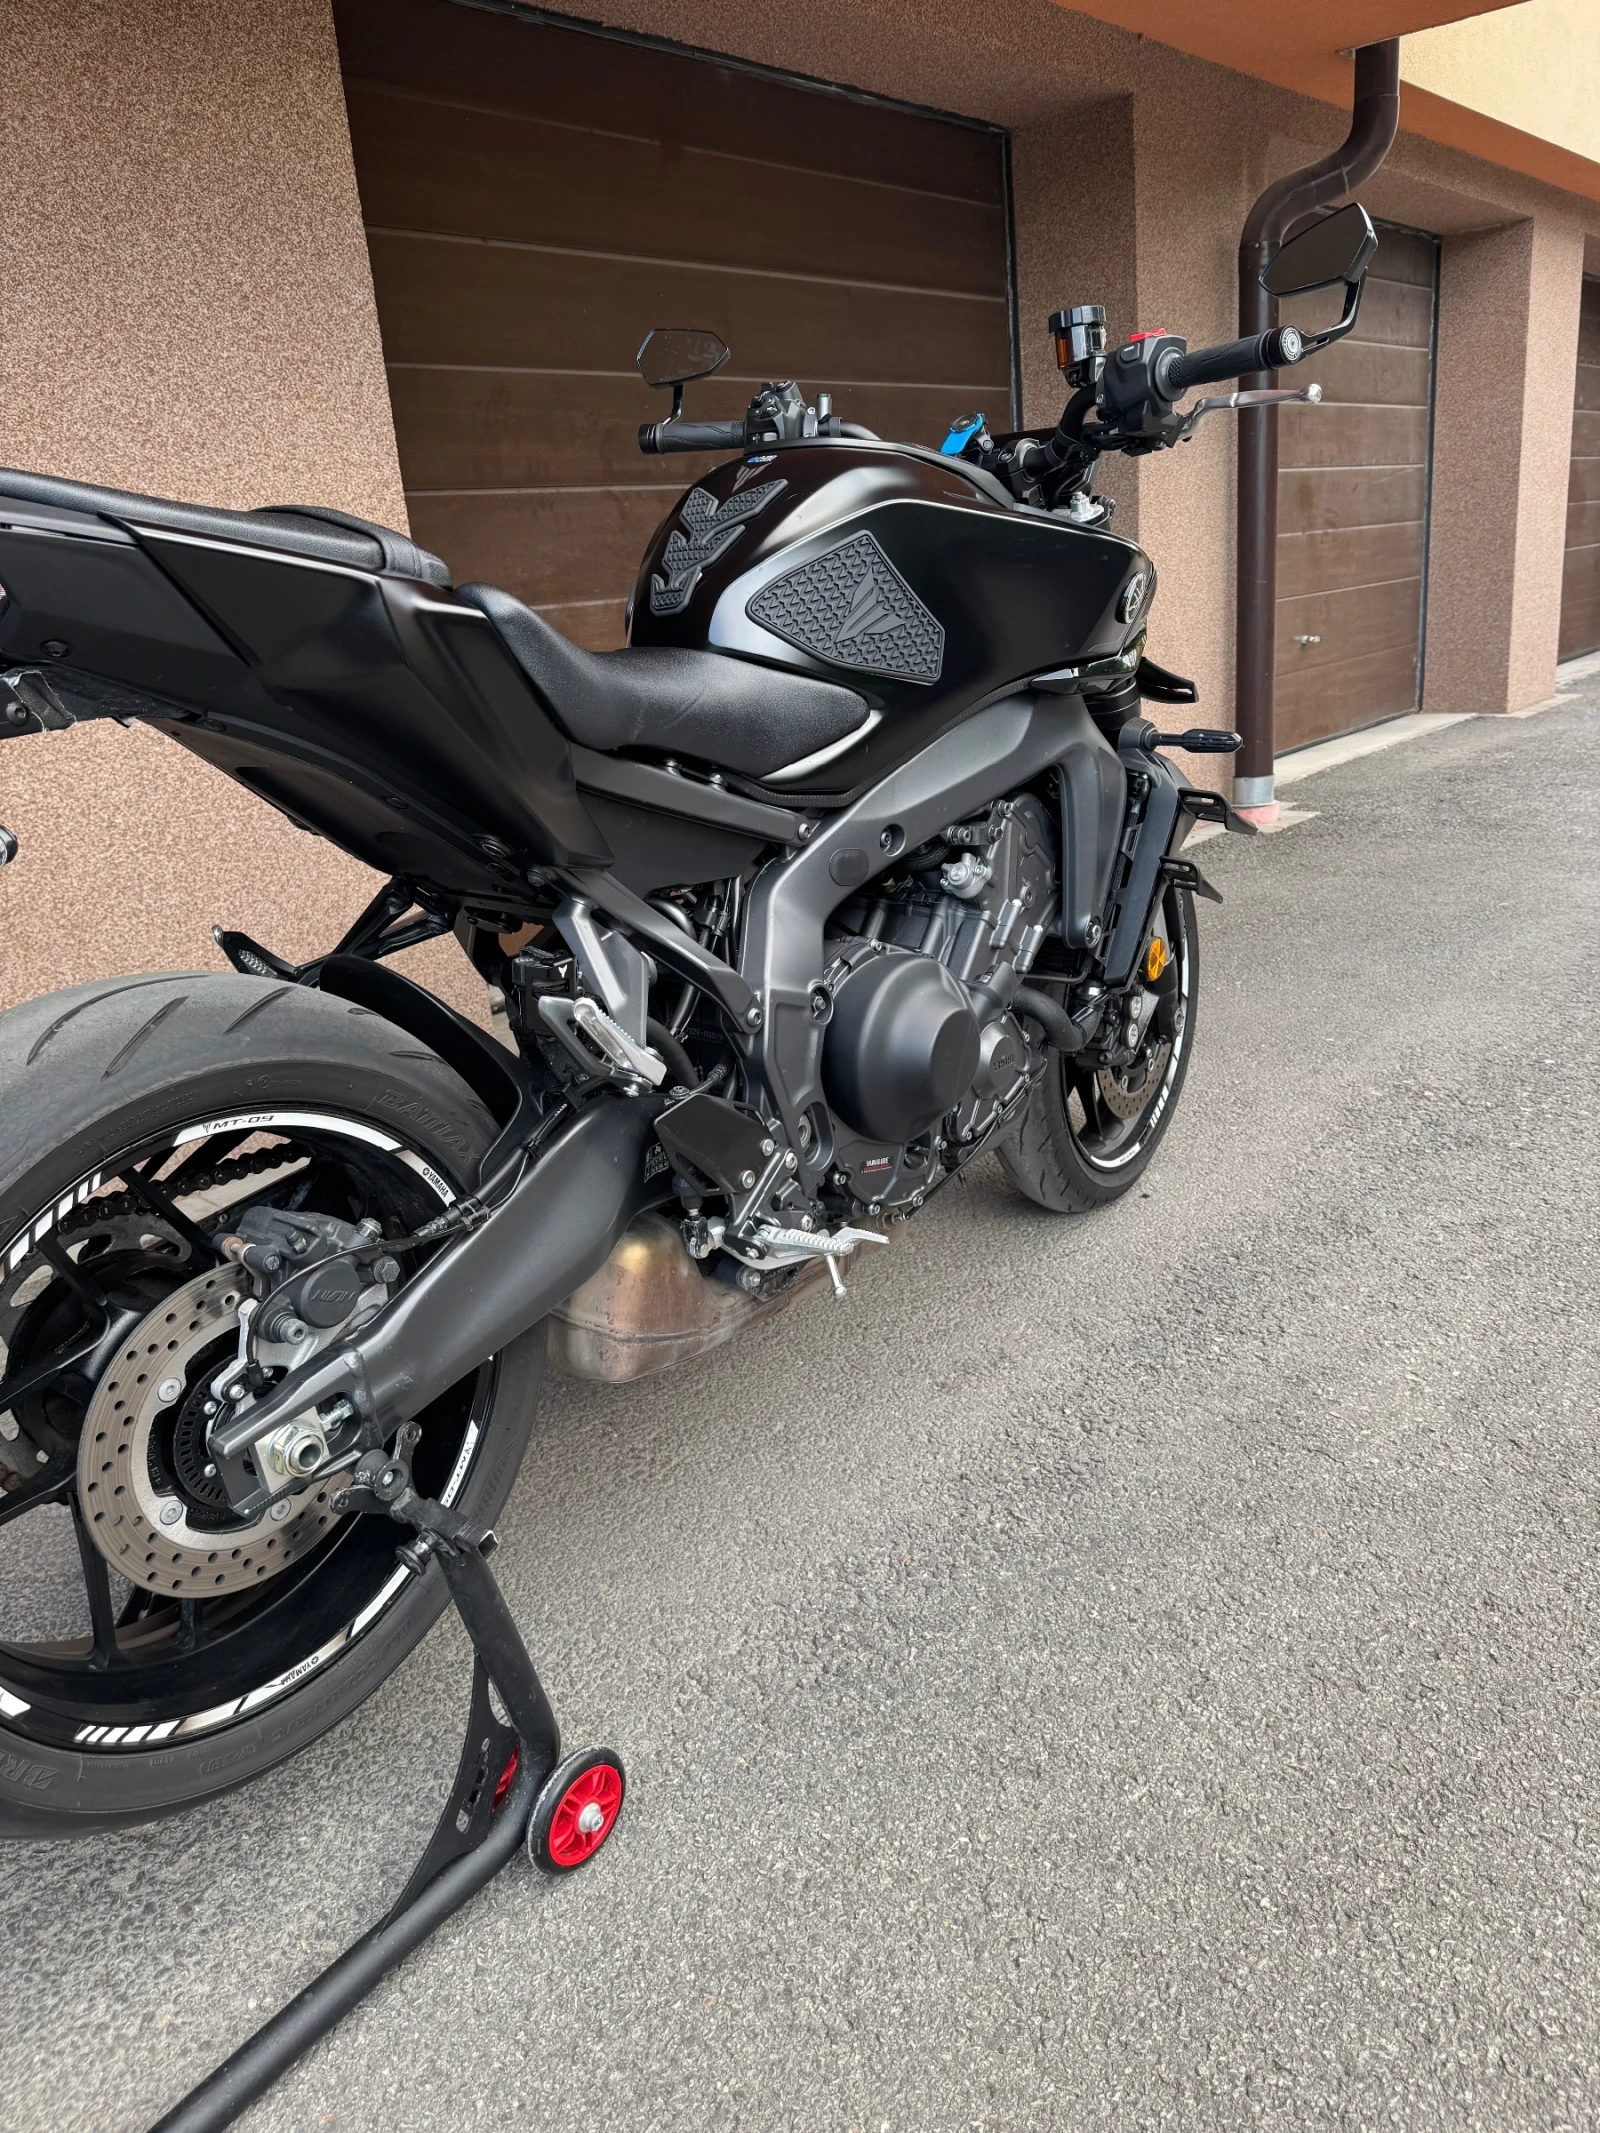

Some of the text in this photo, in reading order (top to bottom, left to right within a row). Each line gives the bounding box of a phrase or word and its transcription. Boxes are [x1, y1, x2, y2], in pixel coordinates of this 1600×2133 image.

[213, 1115, 275, 1130] MT-09
[377, 1089, 482, 1167] BATTLAX
[429, 1171, 449, 1198] YAMAHA
[280, 1661, 312, 1686] YAMAHA
[0, 1750, 60, 1790] BR
